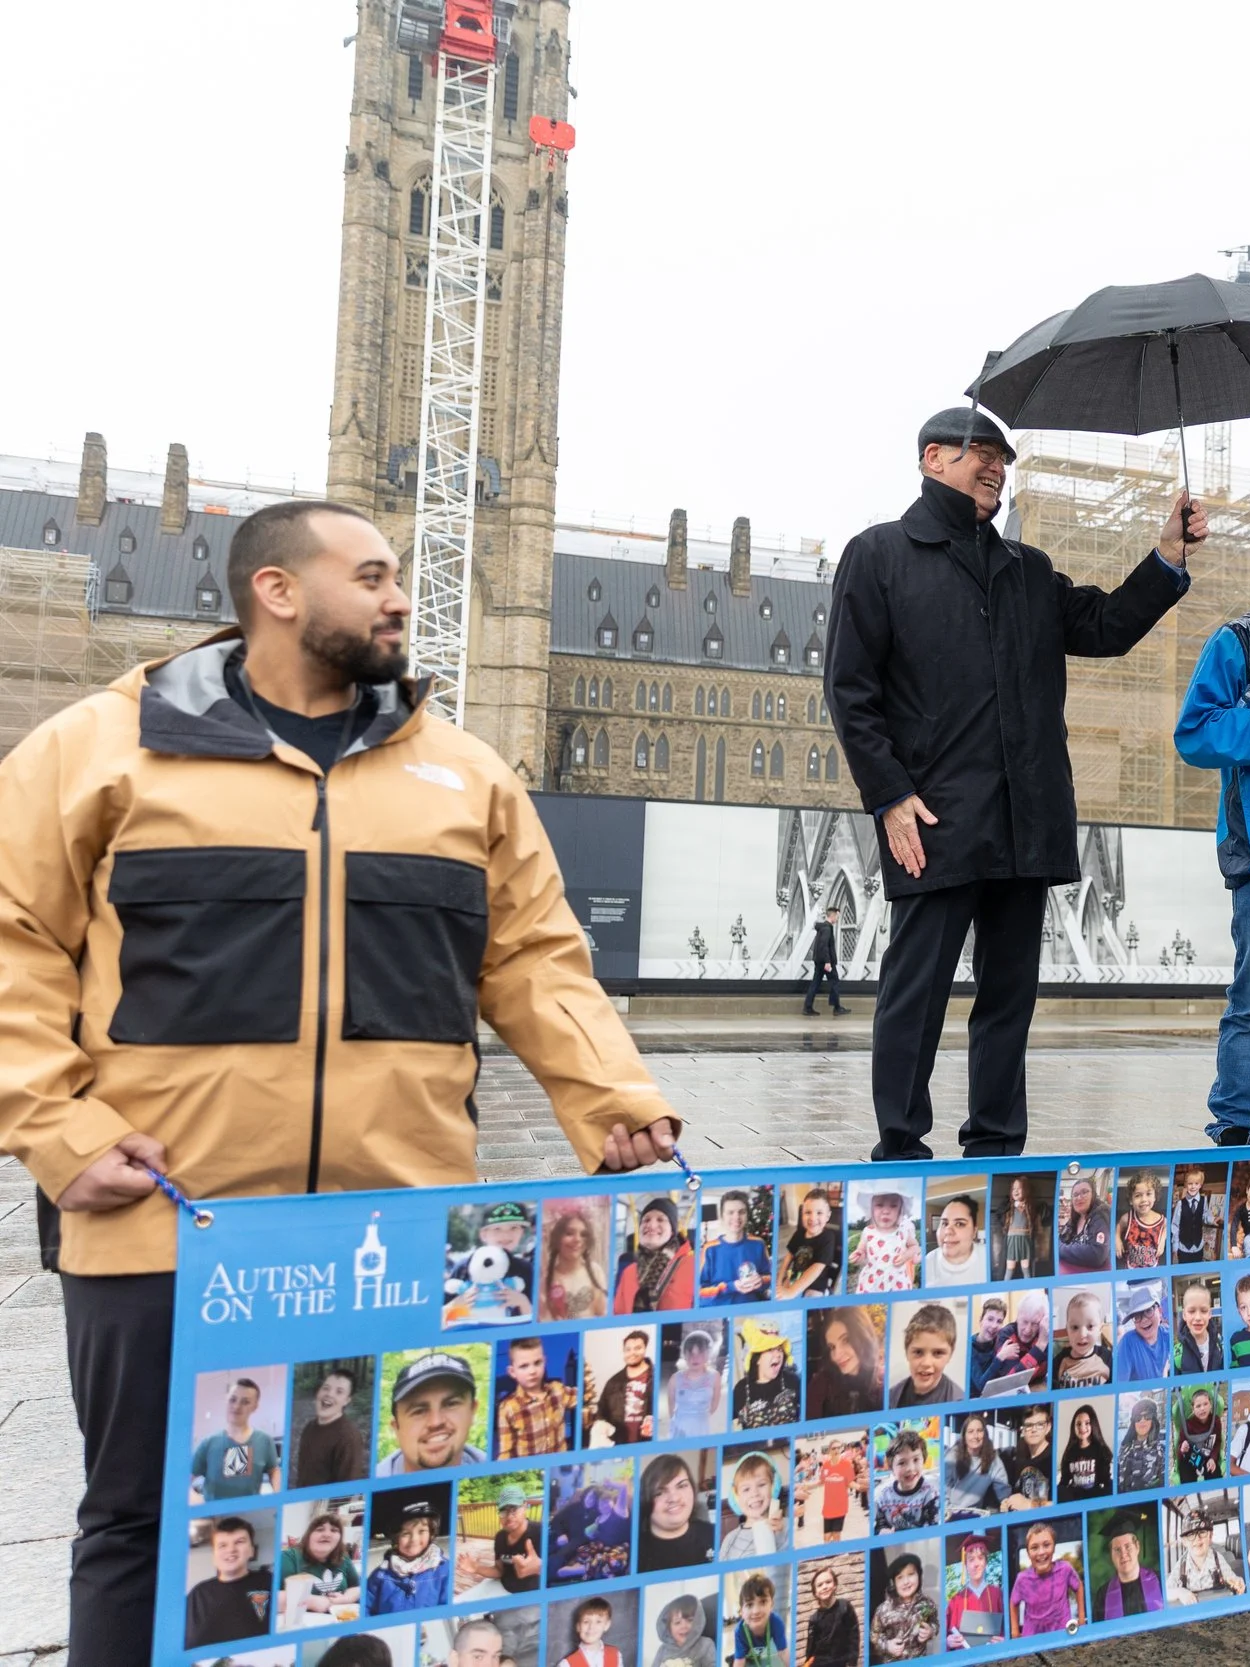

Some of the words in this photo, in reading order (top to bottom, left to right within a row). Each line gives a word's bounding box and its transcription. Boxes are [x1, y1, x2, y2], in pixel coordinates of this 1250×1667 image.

[201, 1295, 254, 1325] ON
[272, 1288, 337, 1318] THE
[352, 1275, 430, 1311] HILL
[203, 1262, 337, 1298] AUTISM
